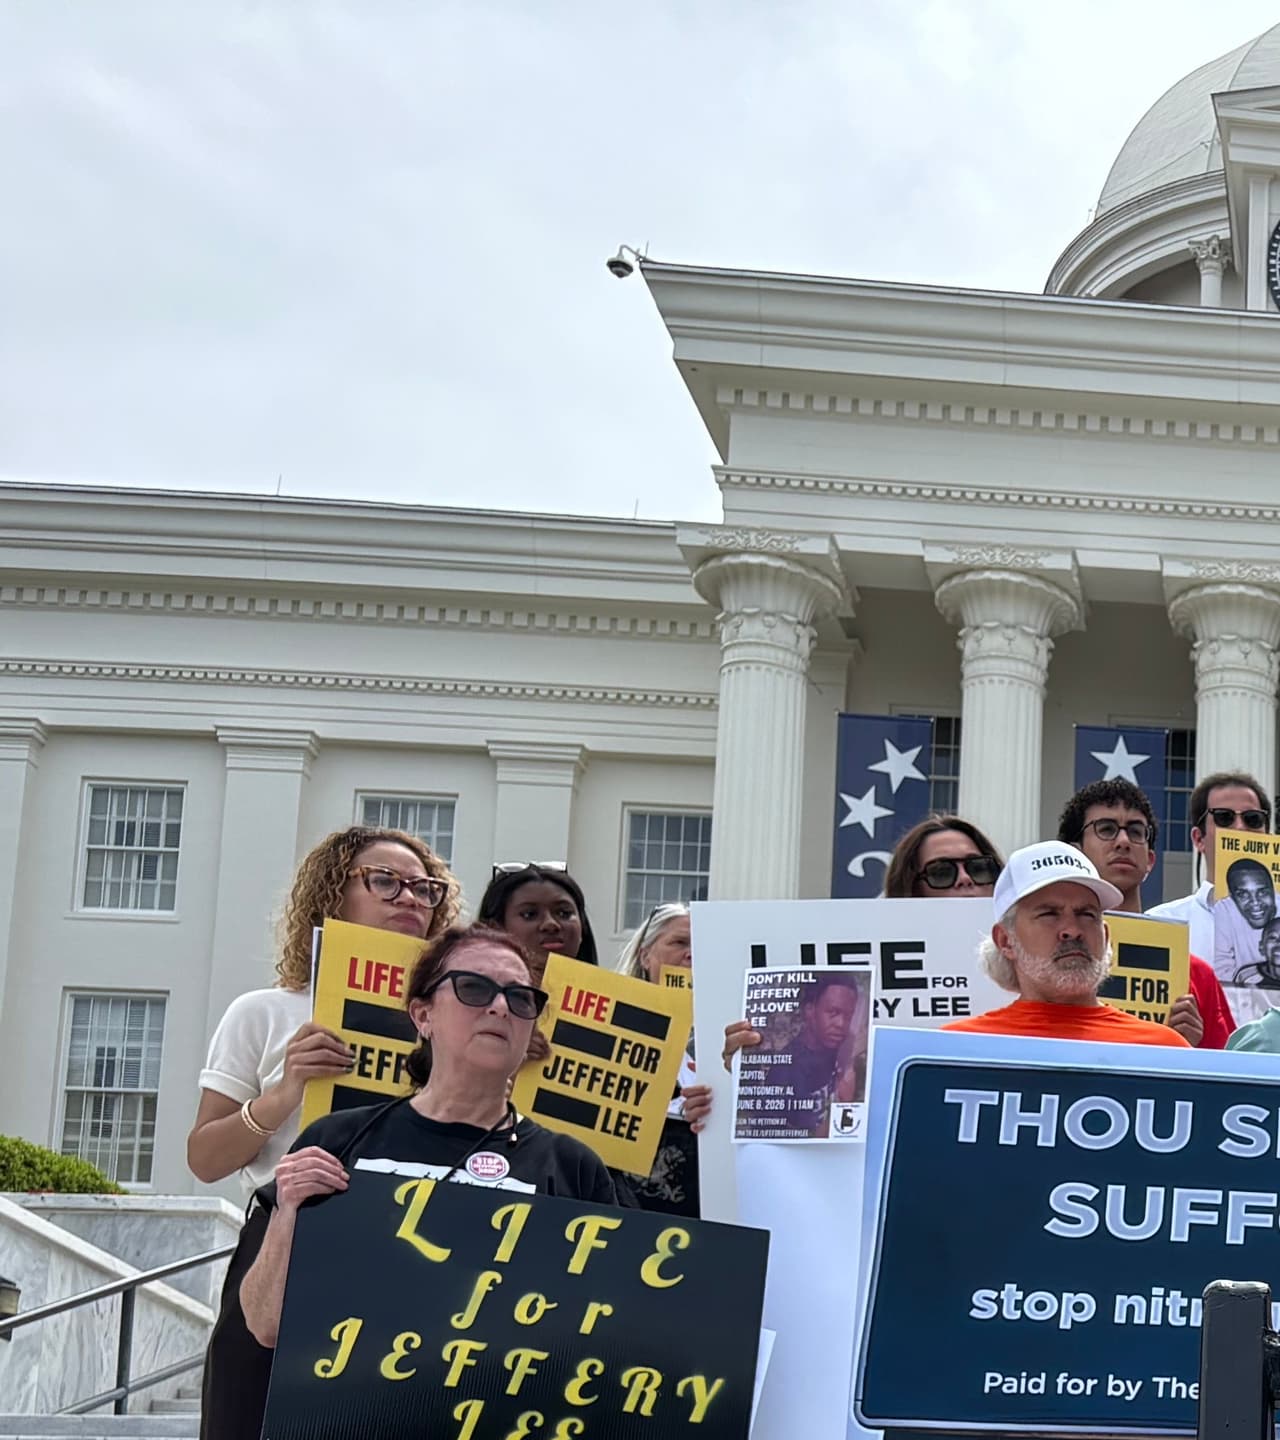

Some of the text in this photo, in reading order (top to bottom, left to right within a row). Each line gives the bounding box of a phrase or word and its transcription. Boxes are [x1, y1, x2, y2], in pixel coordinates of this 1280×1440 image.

[1221, 837, 1240, 851] THE
[1243, 840, 1270, 855] JURY
[347, 957, 406, 998] LIFE
[665, 974, 685, 988] THE
[748, 972, 816, 985] DON'T KILL
[932, 976, 968, 988] FOR
[1130, 978, 1169, 1004] FOR
[561, 986, 611, 1023] LIFE
[746, 988, 800, 1000] JEFFERY
[913, 997, 970, 1017] LEE
[615, 1039, 662, 1074] FOR
[773, 1054, 793, 1064] STATE
[542, 1056, 649, 1106] JEFFERY
[740, 1070, 766, 1080] CAPITOL
[765, 1100, 785, 1110] 2026
[793, 1100, 814, 1110] 11AM
[943, 1087, 1194, 1154] THOU
[600, 1110, 642, 1142] LEE
[393, 1178, 691, 1288] LIFE
[450, 1271, 613, 1335] for
[970, 1283, 1097, 1331] stop
[313, 1317, 724, 1423] JEFFERY
[983, 1371, 1200, 1402] Paid for by The
